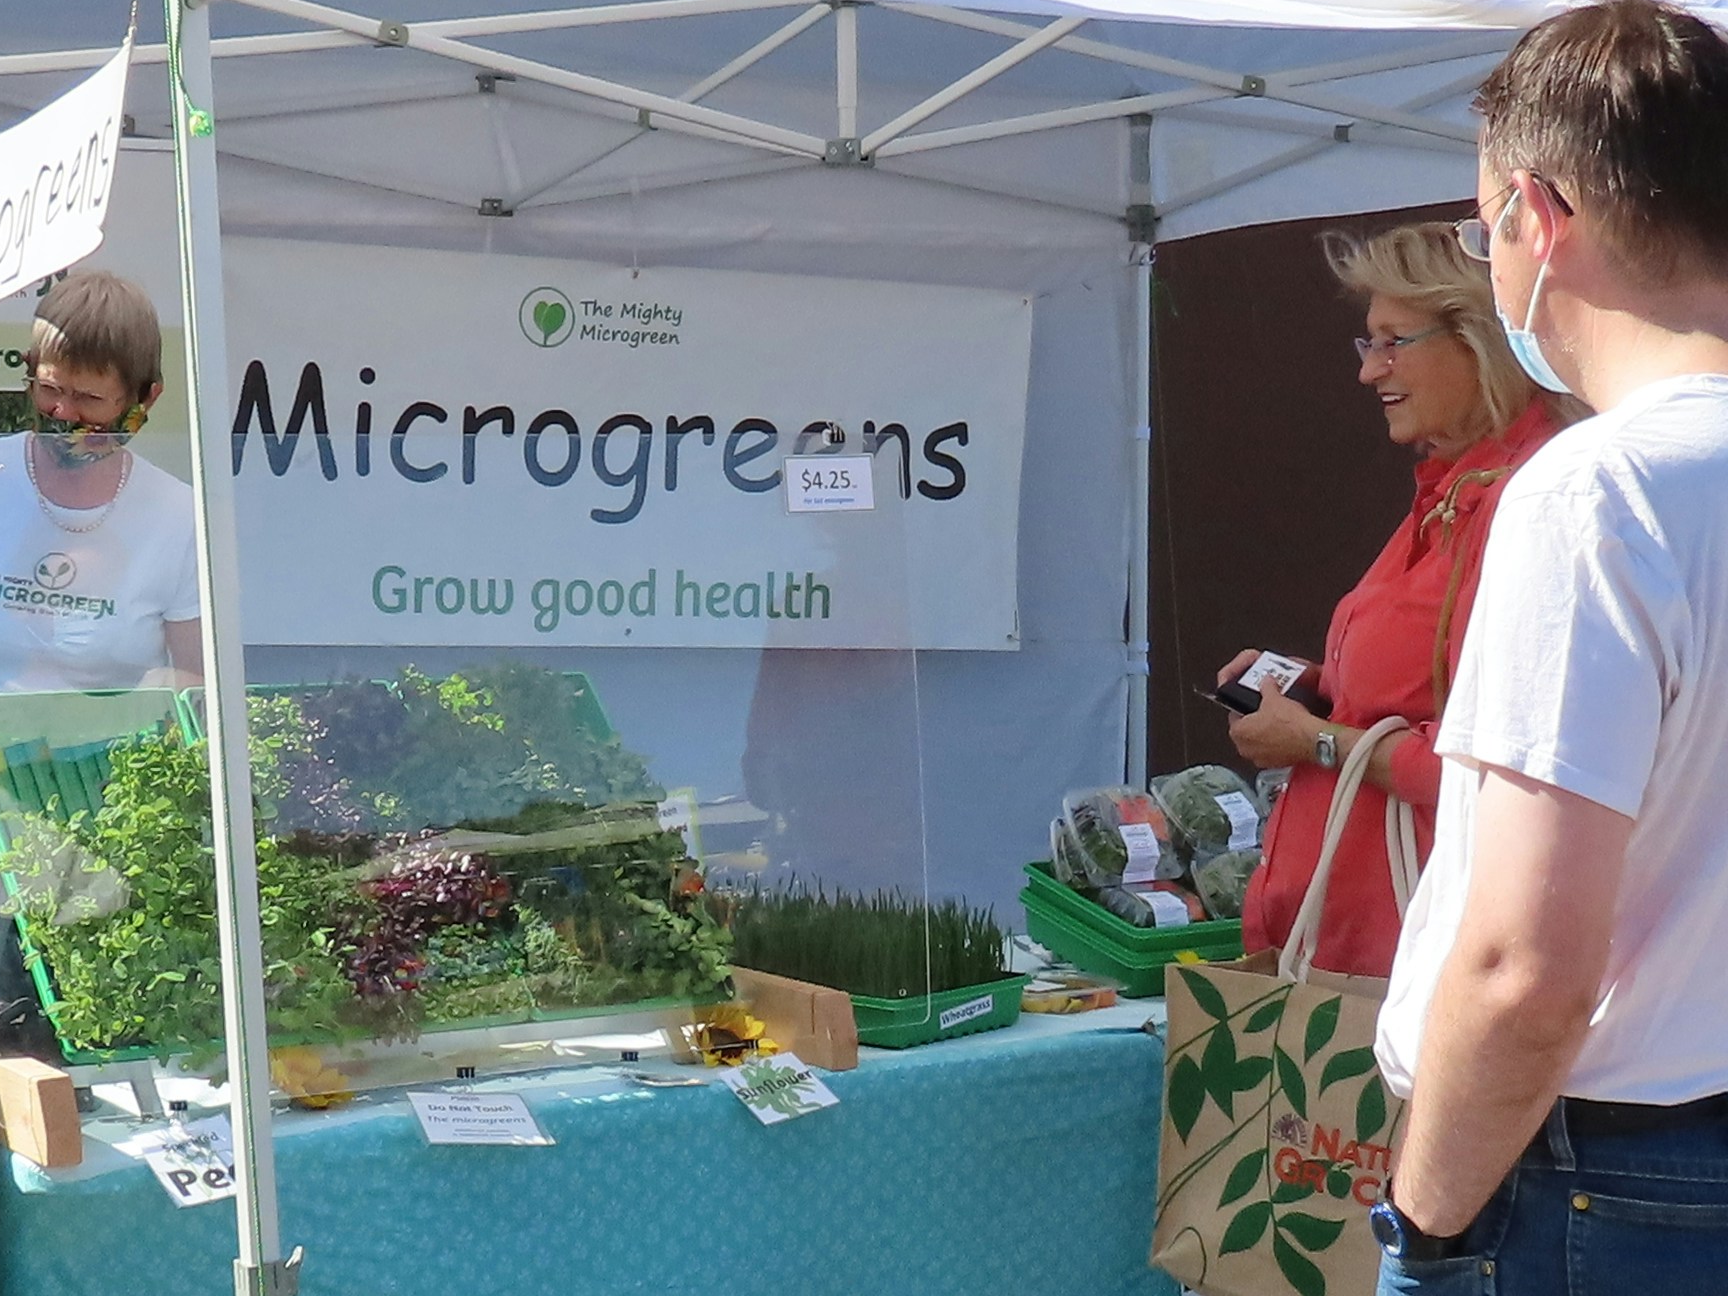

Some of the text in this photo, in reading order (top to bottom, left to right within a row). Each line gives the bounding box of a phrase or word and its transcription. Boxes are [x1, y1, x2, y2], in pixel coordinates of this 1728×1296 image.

[580, 300, 683, 327] The Mighty
[580, 324, 681, 348] Microgreen
[232, 359, 970, 524] Microgreens
[801, 468, 851, 492] $4.25
[371, 565, 831, 632] Grow good health
[736, 1070, 813, 1100] Sunflower
[427, 1115, 527, 1125] The microgreens
[474, 1104, 514, 1113] Touch
[166, 1164, 235, 1197] Pe
